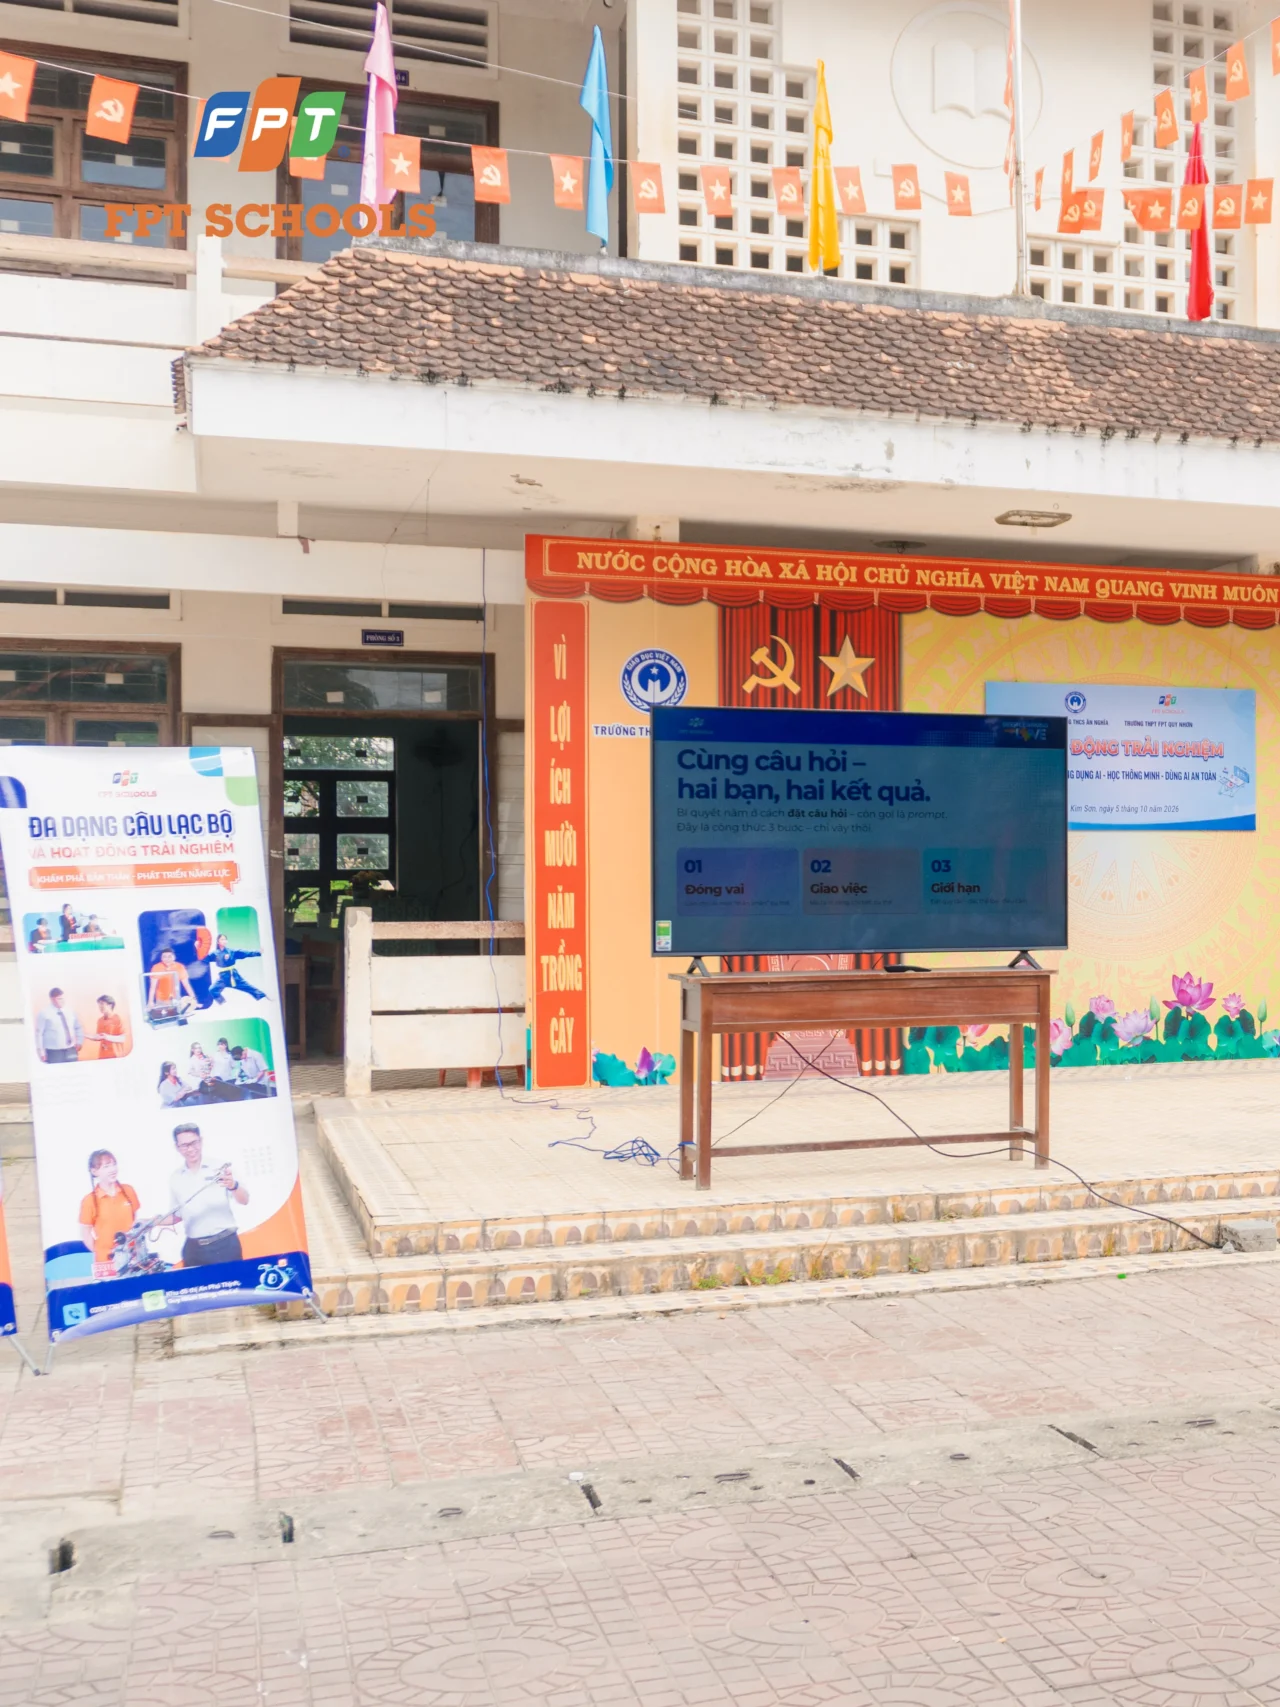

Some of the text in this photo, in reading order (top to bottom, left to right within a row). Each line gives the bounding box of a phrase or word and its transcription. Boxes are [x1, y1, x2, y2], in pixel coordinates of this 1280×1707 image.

[577, 549, 645, 572] NƯỚC
[652, 552, 718, 578] CỘNG
[725, 555, 771, 578] HÒA
[779, 558, 809, 580] XÃ
[816, 558, 857, 583] HỘI
[864, 563, 909, 585] CHỦ
[916, 567, 985, 589] NGHĨA
[990, 570, 1038, 595] VIỆT
[1044, 576, 1089, 593] NAM
[1095, 578, 1164, 599] QUANG
[1170, 582, 1217, 600] VINH
[1223, 583, 1279, 603] MUÔN
[593, 723, 651, 736] TRƯỜNG TH
[1145, 720, 1157, 728] THPT
[1069, 735, 1225, 762] ĐỘNG TRẢI NGHIỆM
[677, 748, 749, 776] Cùng
[755, 750, 801, 771] câu
[808, 749, 847, 772] hỏi
[1076, 770, 1094, 782] DỤNG
[1095, 770, 1102, 780] AI
[1107, 770, 1120, 782] HỌC
[1121, 769, 1142, 780] THÔNG
[1144, 771, 1160, 780] MINH
[1165, 769, 1182, 781] DÙNG
[1183, 772, 1190, 781] AI
[1191, 772, 1200, 781] AN
[1201, 770, 1217, 781] TOÀN
[678, 777, 931, 806] hai bạn, hai kết quả.
[690, 807, 721, 820] quyết
[761, 808, 785, 818] cách
[787, 808, 806, 820] đặt
[808, 809, 828, 819] câu
[831, 808, 847, 818] hỏi
[857, 809, 876, 819] còn
[896, 809, 905, 819] là
[1070, 805, 1083, 813] Kim
[1099, 806, 1114, 814] ngày
[1116, 805, 1120, 813] 5
[1120, 805, 1139, 814] tháng
[1140, 805, 1147, 813] 10
[1148, 805, 1162, 813] năm
[1164, 805, 1179, 813] 2026
[28, 809, 233, 841] ĐA DẠNG CÂU LẠC BỘ
[677, 822, 697, 833] Đây
[700, 822, 709, 832] là
[711, 822, 740, 834] công
[741, 822, 766, 832] thức
[768, 823, 775, 832] 3
[777, 822, 804, 833] bước
[813, 822, 829, 833] chỉ
[540, 634, 583, 1054] VÌ LỢI ÍCH MƯỜI NĂM TRỒNG CÂY
[684, 859, 702, 873] 01
[810, 859, 832, 873] 02
[931, 859, 951, 873] 03
[36, 872, 63, 883] KHÁM
[137, 870, 161, 881] PHÁT
[162, 867, 187, 880] TRIỂN
[188, 868, 212, 878] NĂNG
[213, 867, 232, 878] LỰC
[684, 882, 745, 897] Đóng vai
[810, 882, 868, 897] Giao việc
[931, 881, 980, 896] Giới hạn
